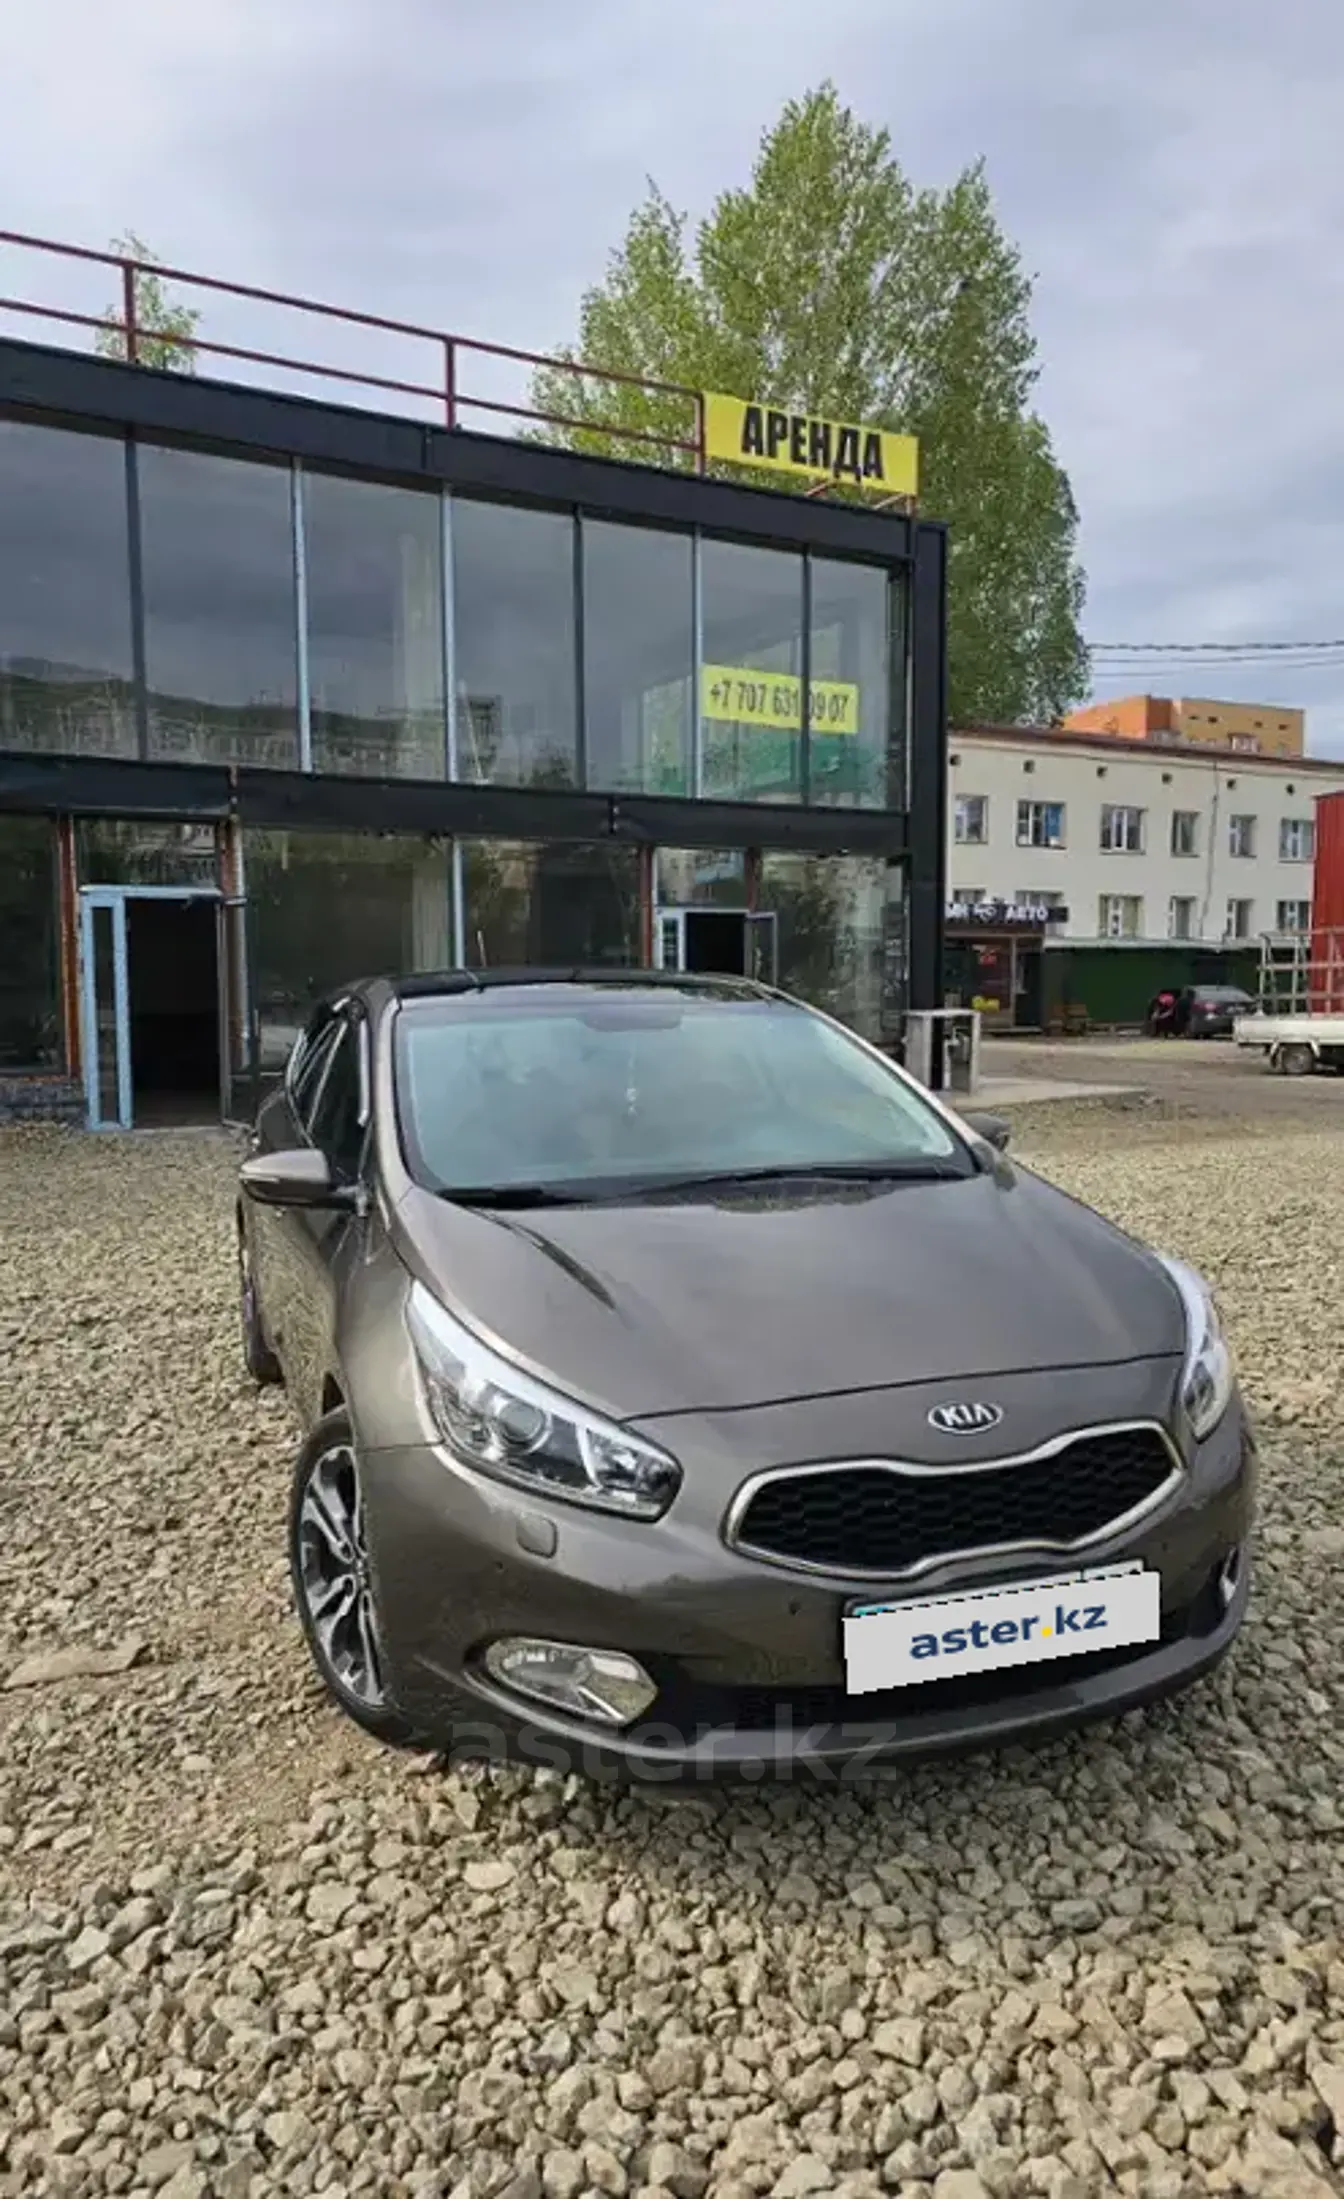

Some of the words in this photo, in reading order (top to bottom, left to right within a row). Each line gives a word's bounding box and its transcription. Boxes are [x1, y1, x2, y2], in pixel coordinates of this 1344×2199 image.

[741, 405, 884, 482] АРЕНДА
[711, 678, 732, 709] +7
[737, 680, 766, 714] 707
[942, 1402, 994, 1427] KIA
